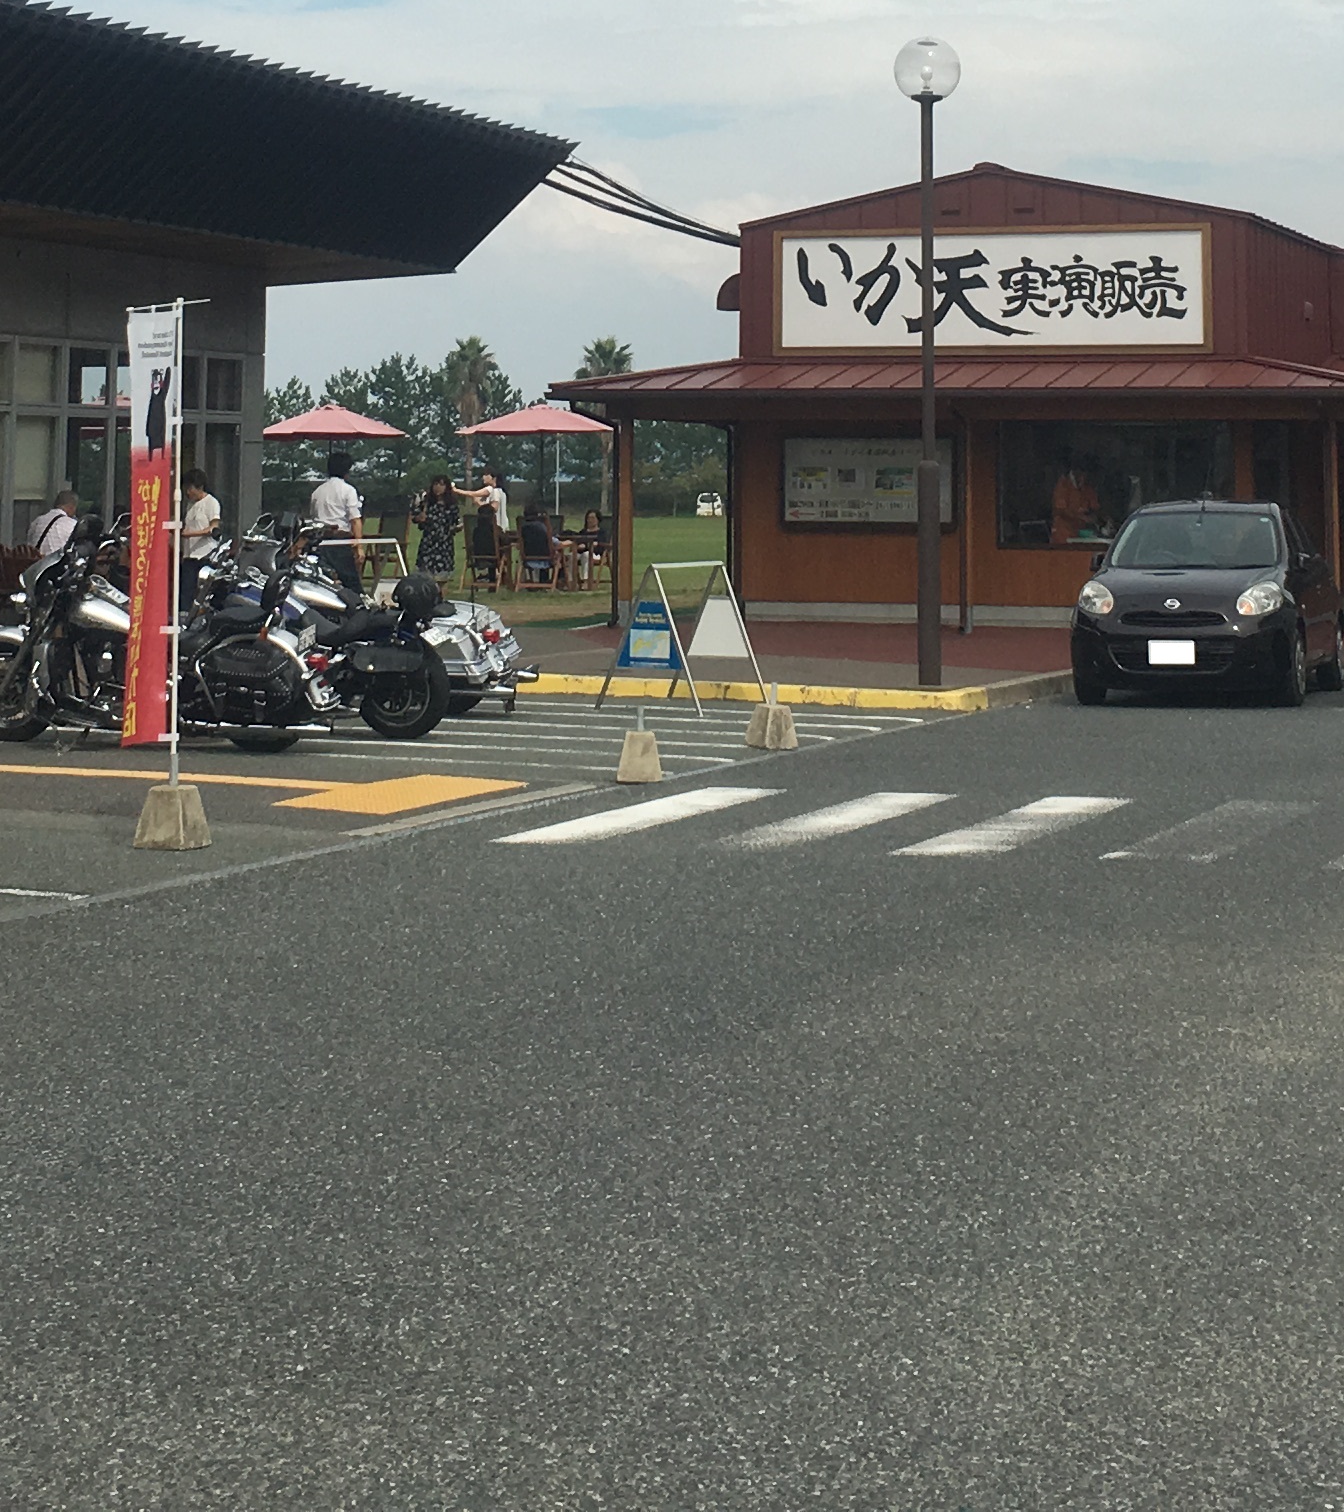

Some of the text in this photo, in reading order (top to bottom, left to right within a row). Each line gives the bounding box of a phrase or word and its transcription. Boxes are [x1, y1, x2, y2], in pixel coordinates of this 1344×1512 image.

[796, 242, 1188, 336] いか天実演販売
